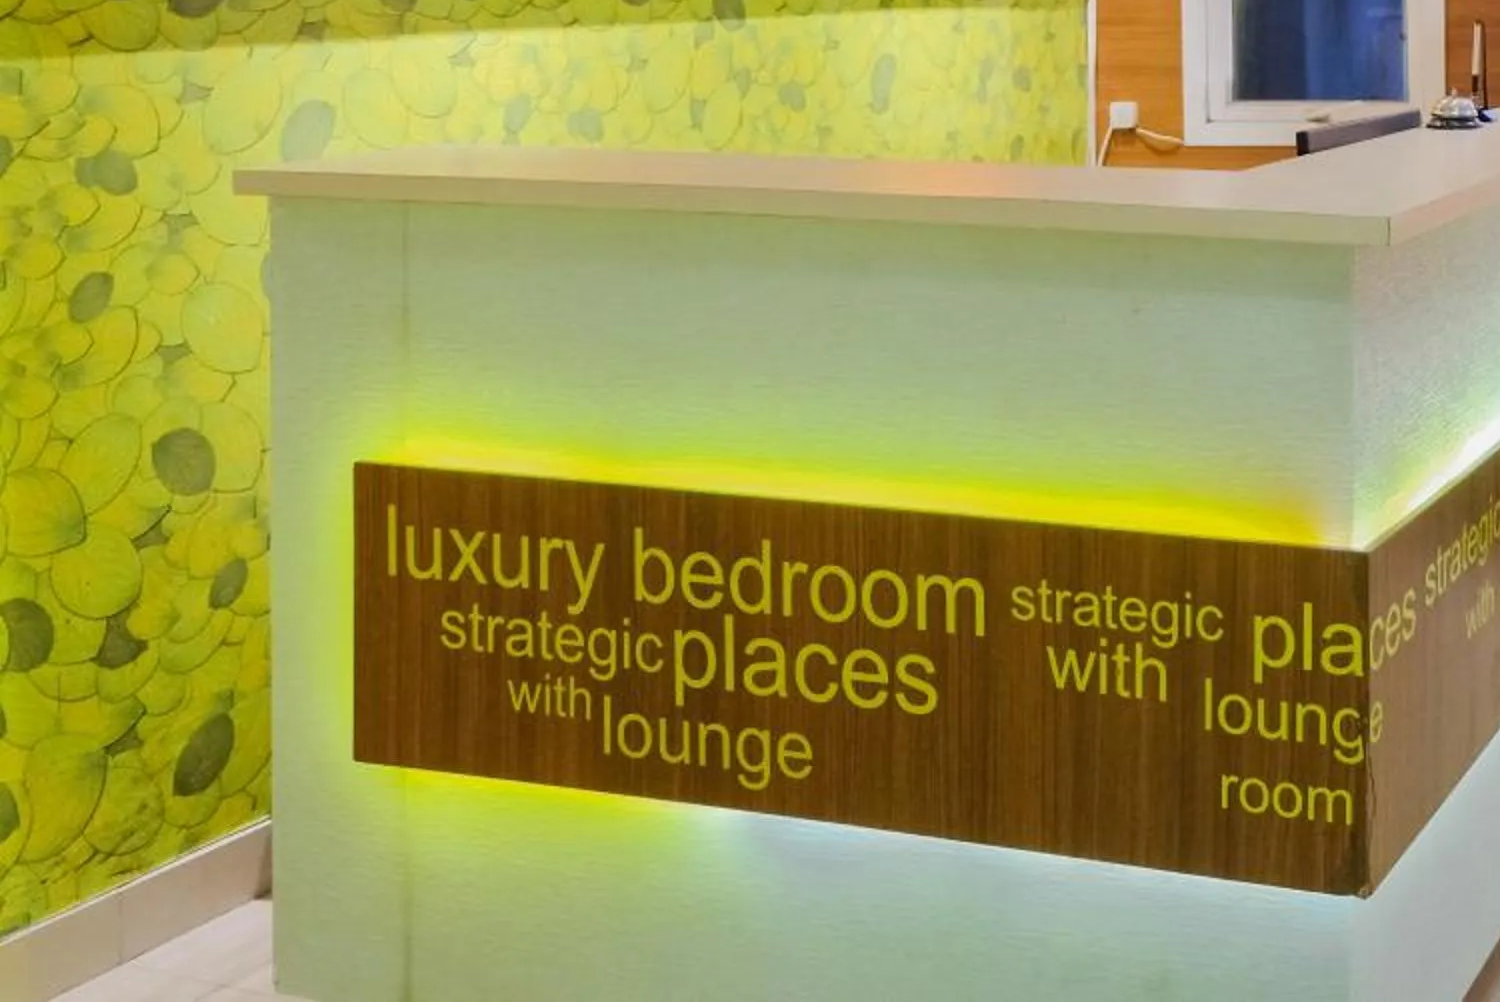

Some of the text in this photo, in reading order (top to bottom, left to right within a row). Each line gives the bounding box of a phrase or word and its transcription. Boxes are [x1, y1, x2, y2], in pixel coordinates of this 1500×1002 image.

[386, 504, 986, 636] luxury bedroom
[1010, 579, 1225, 649] strategic
[1465, 578, 1496, 640] with
[440, 604, 938, 716] strategic places
[1046, 638, 1168, 703] with
[507, 673, 592, 722] with
[603, 695, 814, 792] lounge
[1221, 773, 1354, 826] room
